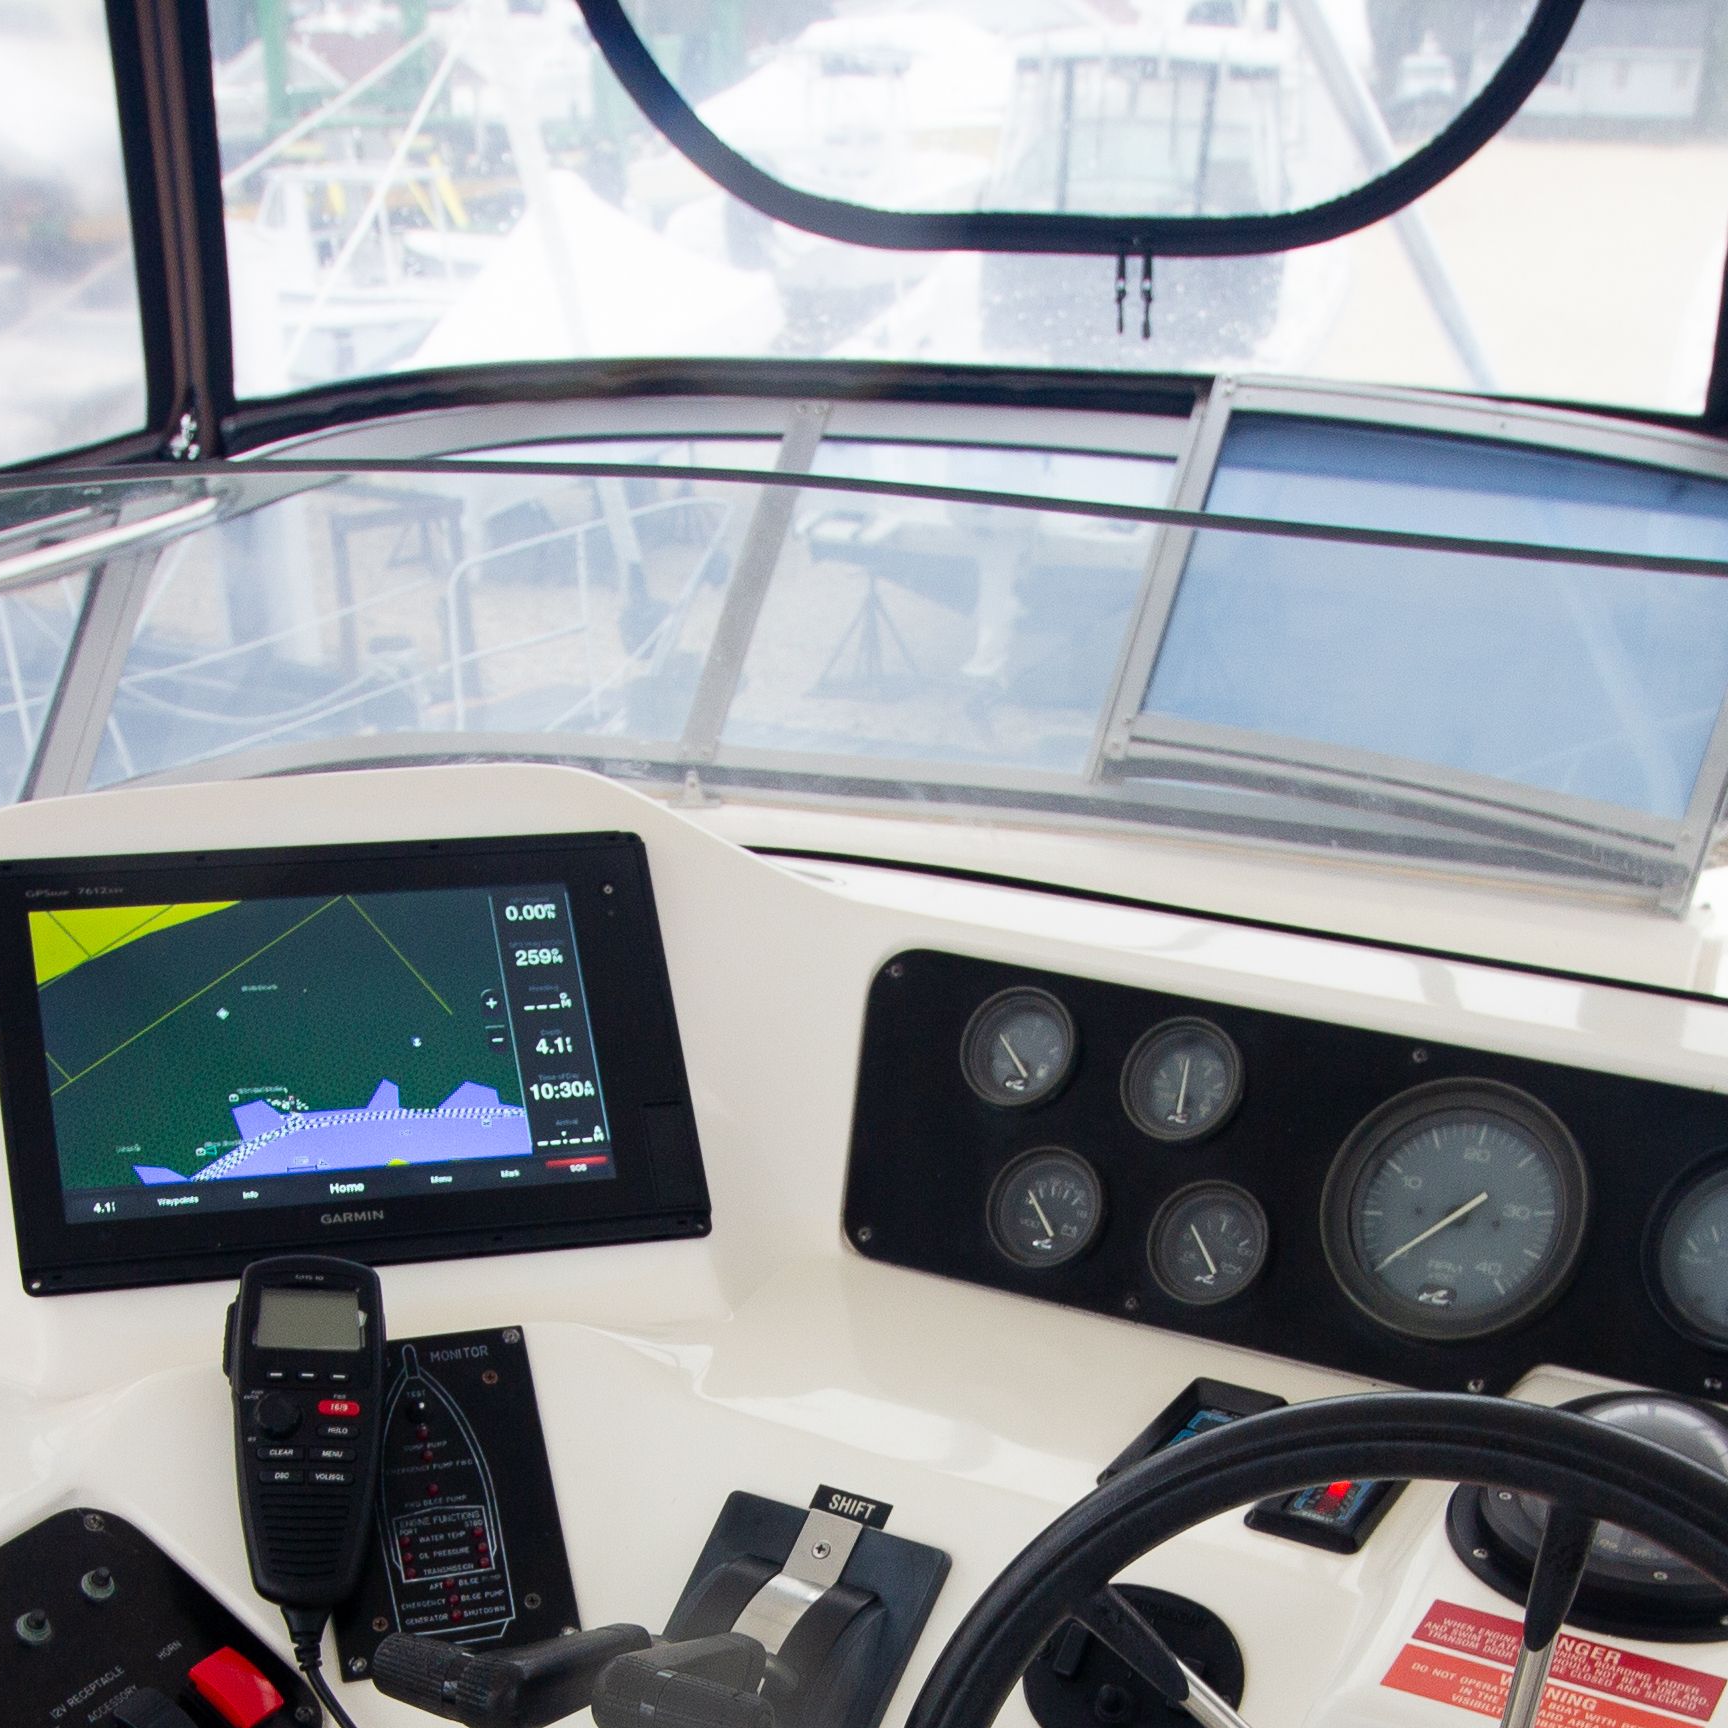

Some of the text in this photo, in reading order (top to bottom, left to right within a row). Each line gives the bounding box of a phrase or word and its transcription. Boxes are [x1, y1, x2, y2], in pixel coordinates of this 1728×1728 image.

[515, 949, 552, 967] 259
[530, 1081, 584, 1101] 10:30
[329, 1182, 365, 1195] Home
[157, 1195, 200, 1208] Waypoints
[320, 1209, 384, 1225] GARMIN
[430, 1345, 489, 1362] MONITOR
[269, 1449, 294, 1458] CLEAR
[321, 1450, 344, 1460] MENU
[829, 1494, 877, 1520] SHIFT
[432, 1510, 481, 1525] FUNCTIONS
[399, 1528, 418, 1537] PORT
[418, 1530, 467, 1544] WATER TEMP
[433, 1546, 471, 1558] PRESSURE
[429, 1581, 444, 1591] AFT
[484, 1589, 505, 1599] PUMP
[405, 1605, 506, 1626] GENERATOR SHUTDOWN
[156, 1639, 183, 1661] HORN
[1443, 1617, 1476, 1636] WHEN
[1479, 1628, 1519, 1645] ENGINE
[1594, 1657, 1653, 1683] BOARDING
[1655, 1676, 1701, 1696] LADDER
[1423, 1620, 1448, 1633] AND
[1451, 1626, 1482, 1643] SWIM
[1552, 1656, 1592, 1673] HOULD
[1594, 1667, 1616, 1679] NOT
[1656, 1685, 1680, 1698] USE
[1428, 1630, 1480, 1649] TRANSOM
[1482, 1645, 1514, 1660] DOOR
[1569, 1668, 1613, 1688] CLOSED
[1615, 1684, 1642, 1697] AND
[49, 1664, 126, 1721] 12V RECEPTACLE
[1411, 1660, 1429, 1673] DO
[1432, 1668, 1458, 1682] NOT
[1548, 1700, 1582, 1717] BOAT
[1584, 1711, 1618, 1728] WITH
[1478, 1690, 1500, 1705] THE
[87, 1683, 138, 1723] ACCESSORY
[1451, 1694, 1504, 1715] VISIBILIT
